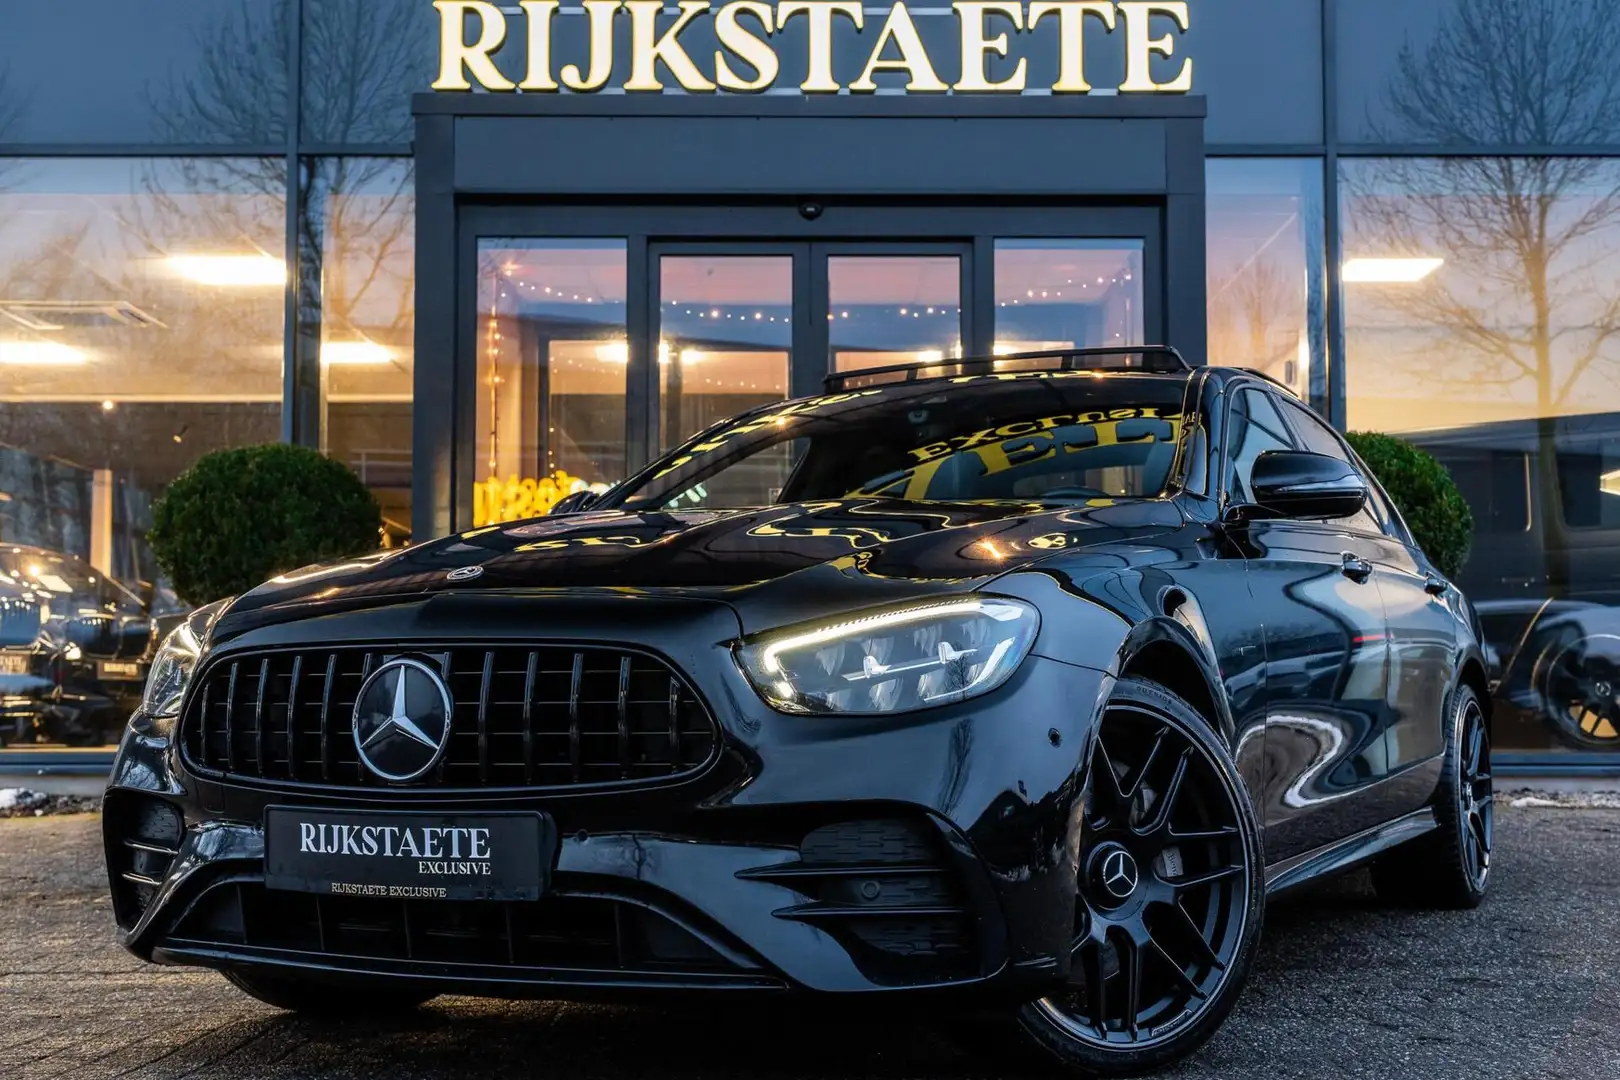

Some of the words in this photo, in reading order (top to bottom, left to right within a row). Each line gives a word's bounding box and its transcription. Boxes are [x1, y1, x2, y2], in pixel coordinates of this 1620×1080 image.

[431, 0, 1193, 92] RIJKSTAETE
[300, 822, 490, 859] RIJKSTAETE
[418, 861, 491, 875] EXCLUSIVE
[331, 882, 388, 896] RIJKSTAETE
[389, 886, 447, 898] EXCLUSIVE
